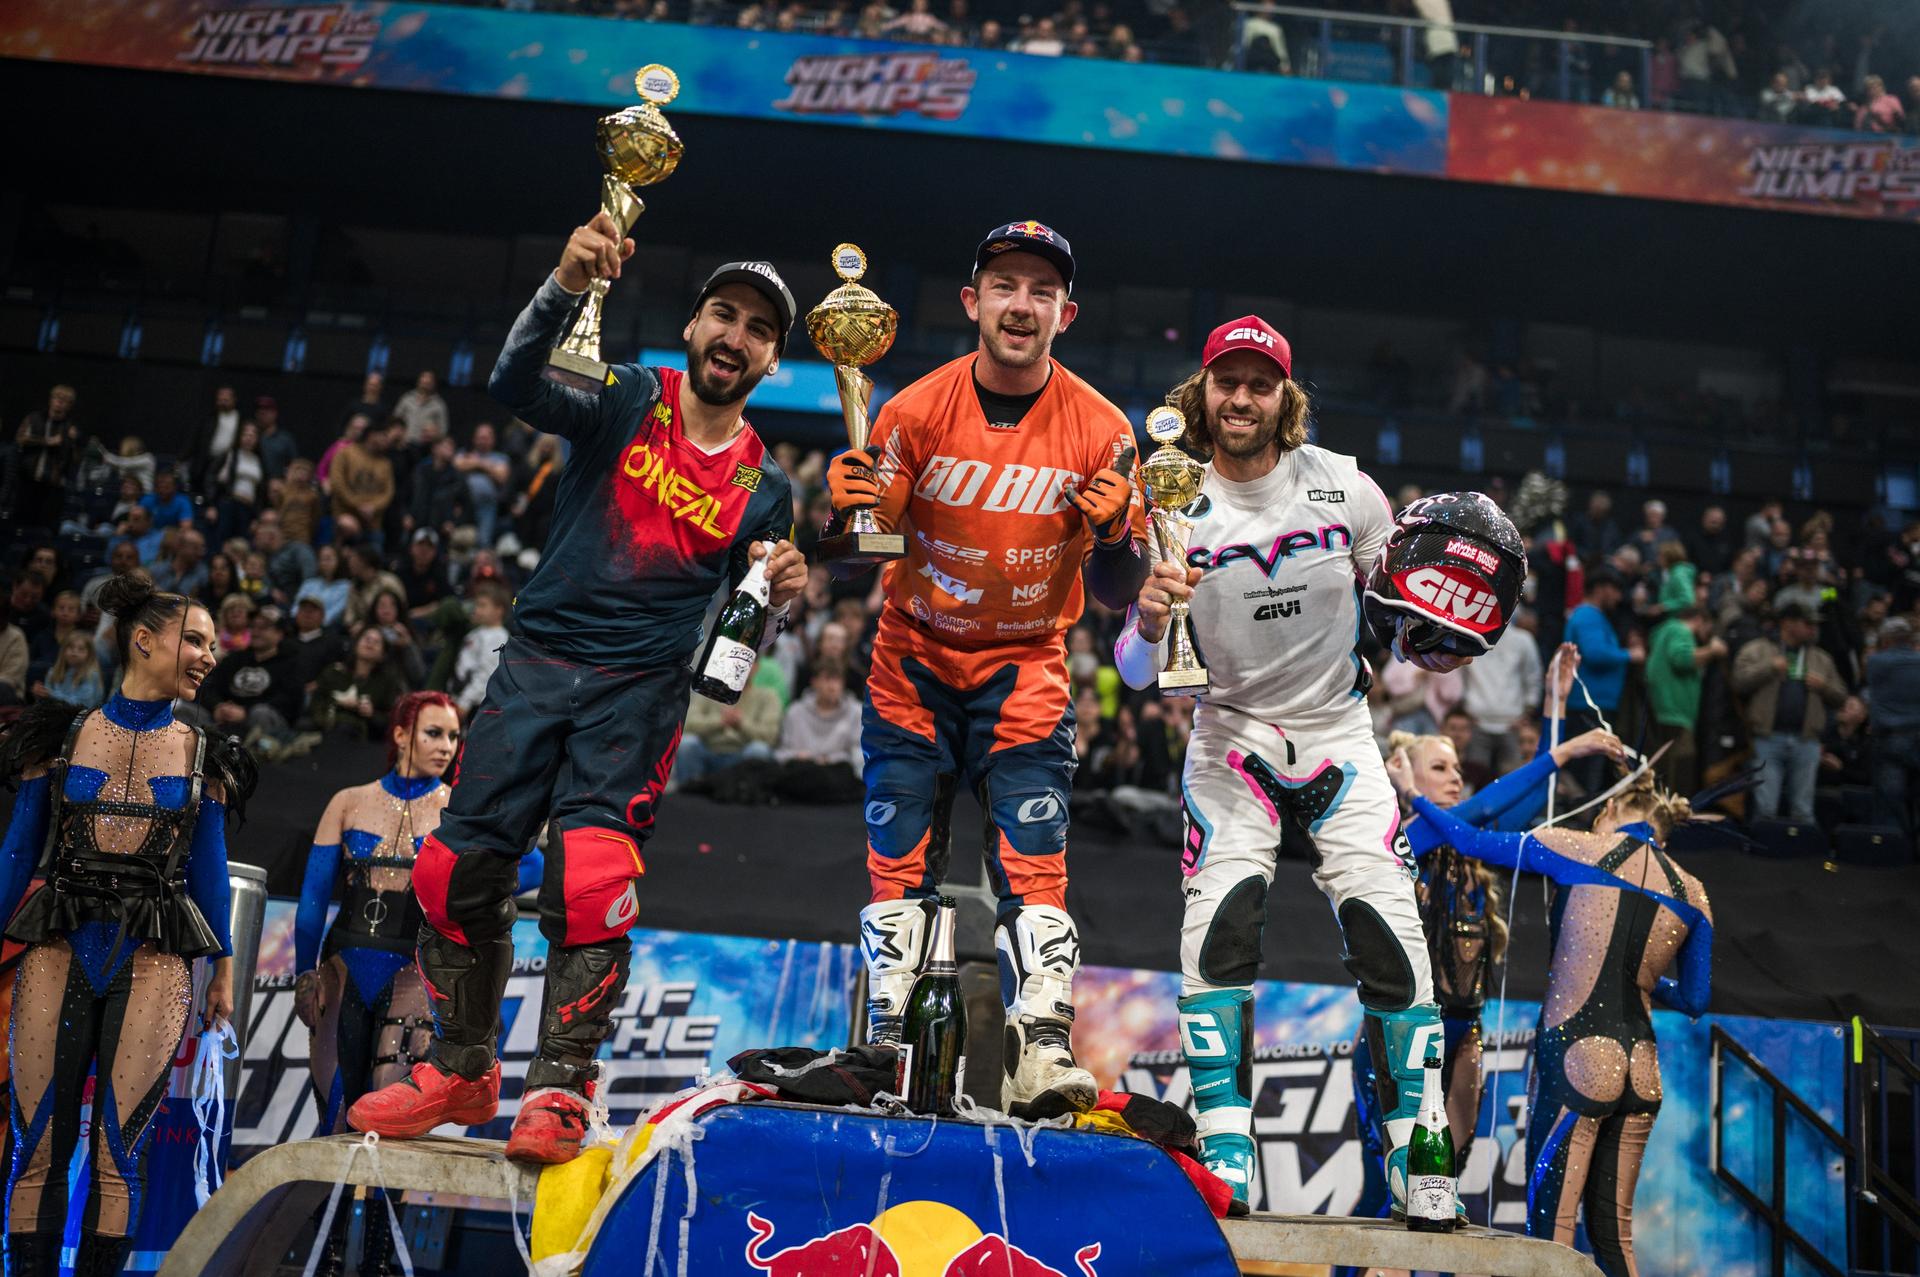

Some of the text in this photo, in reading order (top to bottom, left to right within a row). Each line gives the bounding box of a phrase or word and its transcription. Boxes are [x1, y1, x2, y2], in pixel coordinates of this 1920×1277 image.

[190, 8, 337, 37] NIGHT
[175, 35, 374, 63] JUMPS
[785, 54, 936, 82] NIGHT
[771, 82, 972, 111] JUMPS
[1745, 145, 1887, 173] NIGHT
[1738, 171, 1920, 199] JUMPS
[1225, 328, 1277, 349] GIVI
[913, 455, 992, 507] GO
[981, 463, 1085, 516] BIG
[1309, 490, 1345, 502] MOTUL
[917, 530, 989, 559] LS2
[1005, 540, 1068, 565] SPECT
[917, 561, 985, 605] KTM
[1011, 576, 1051, 601] NGK
[1405, 567, 1498, 625] GIVI
[935, 611, 981, 630] CARBON
[1253, 600, 1301, 621] GIVI
[934, 619, 967, 635] DRIVE
[1253, 1040, 1320, 1060] WORLD
[157, 1127, 198, 1145] INK
